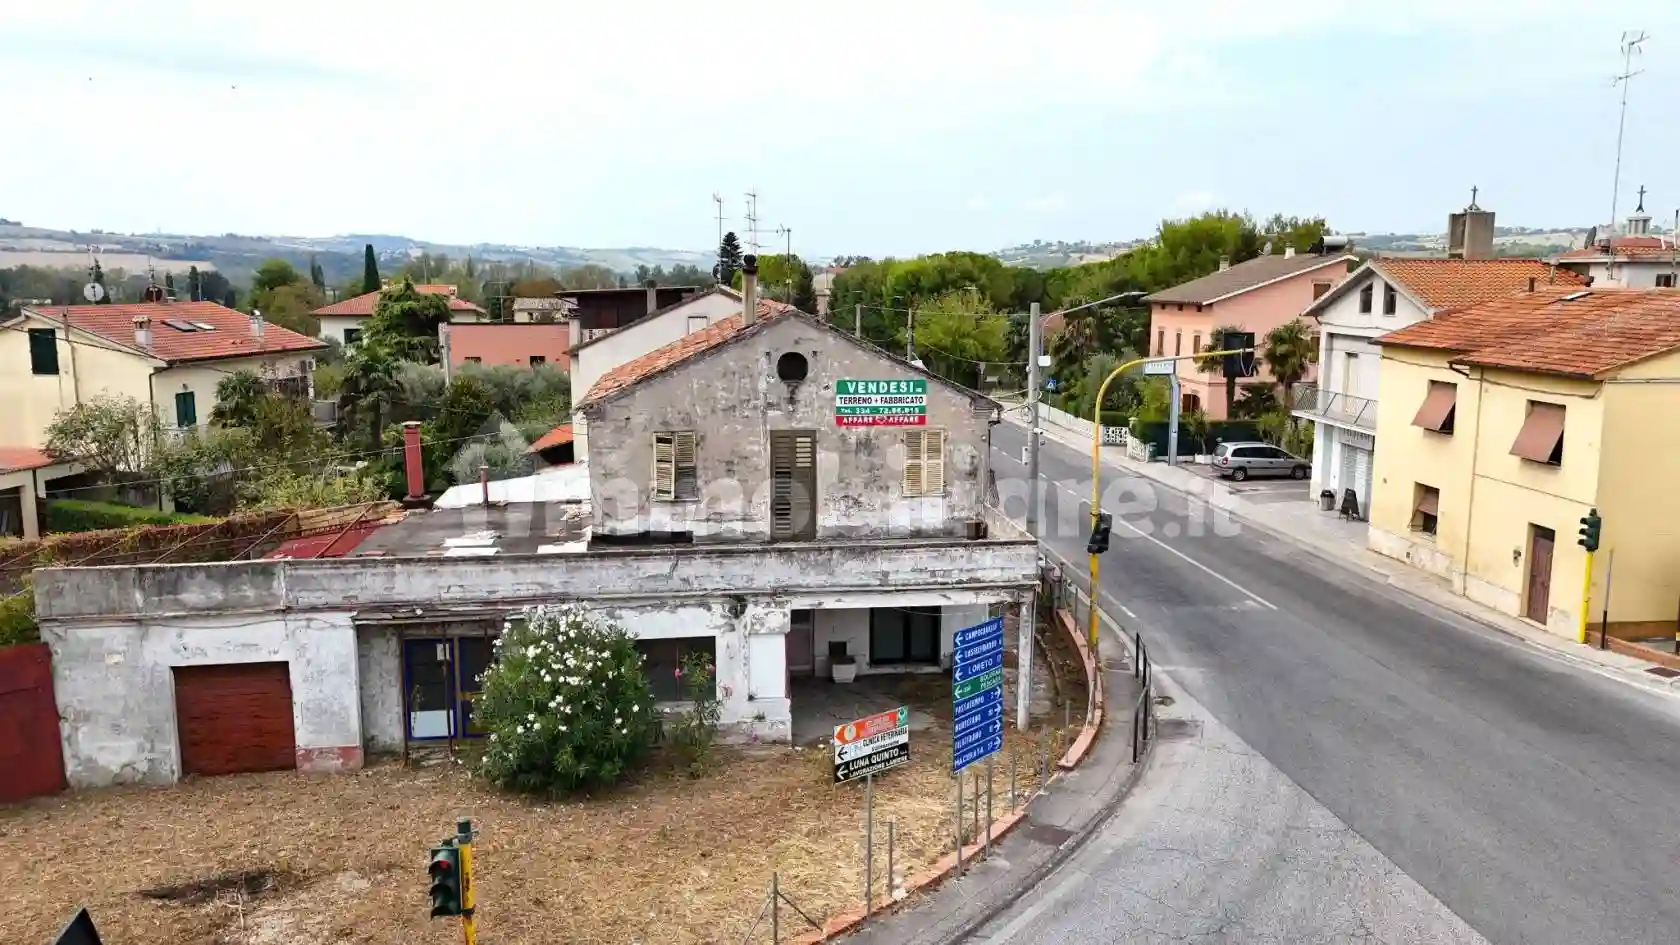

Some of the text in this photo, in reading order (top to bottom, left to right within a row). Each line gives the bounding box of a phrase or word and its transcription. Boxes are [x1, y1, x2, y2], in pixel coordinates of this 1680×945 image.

[846, 381, 914, 394] VENDESI
[839, 396, 872, 405] TERRENO
[880, 396, 924, 405] FABBRICATO
[842, 415, 919, 425] AFFARE AFFARE
[968, 658, 993, 675] LORETO
[862, 735, 880, 747] CLINICA
[880, 727, 908, 741] VETERINARIA
[849, 757, 870, 770] LUNA
[870, 747, 899, 764] QUINTO
[955, 746, 984, 768] MACERATA
[849, 762, 885, 778] LAVORAZIONE
